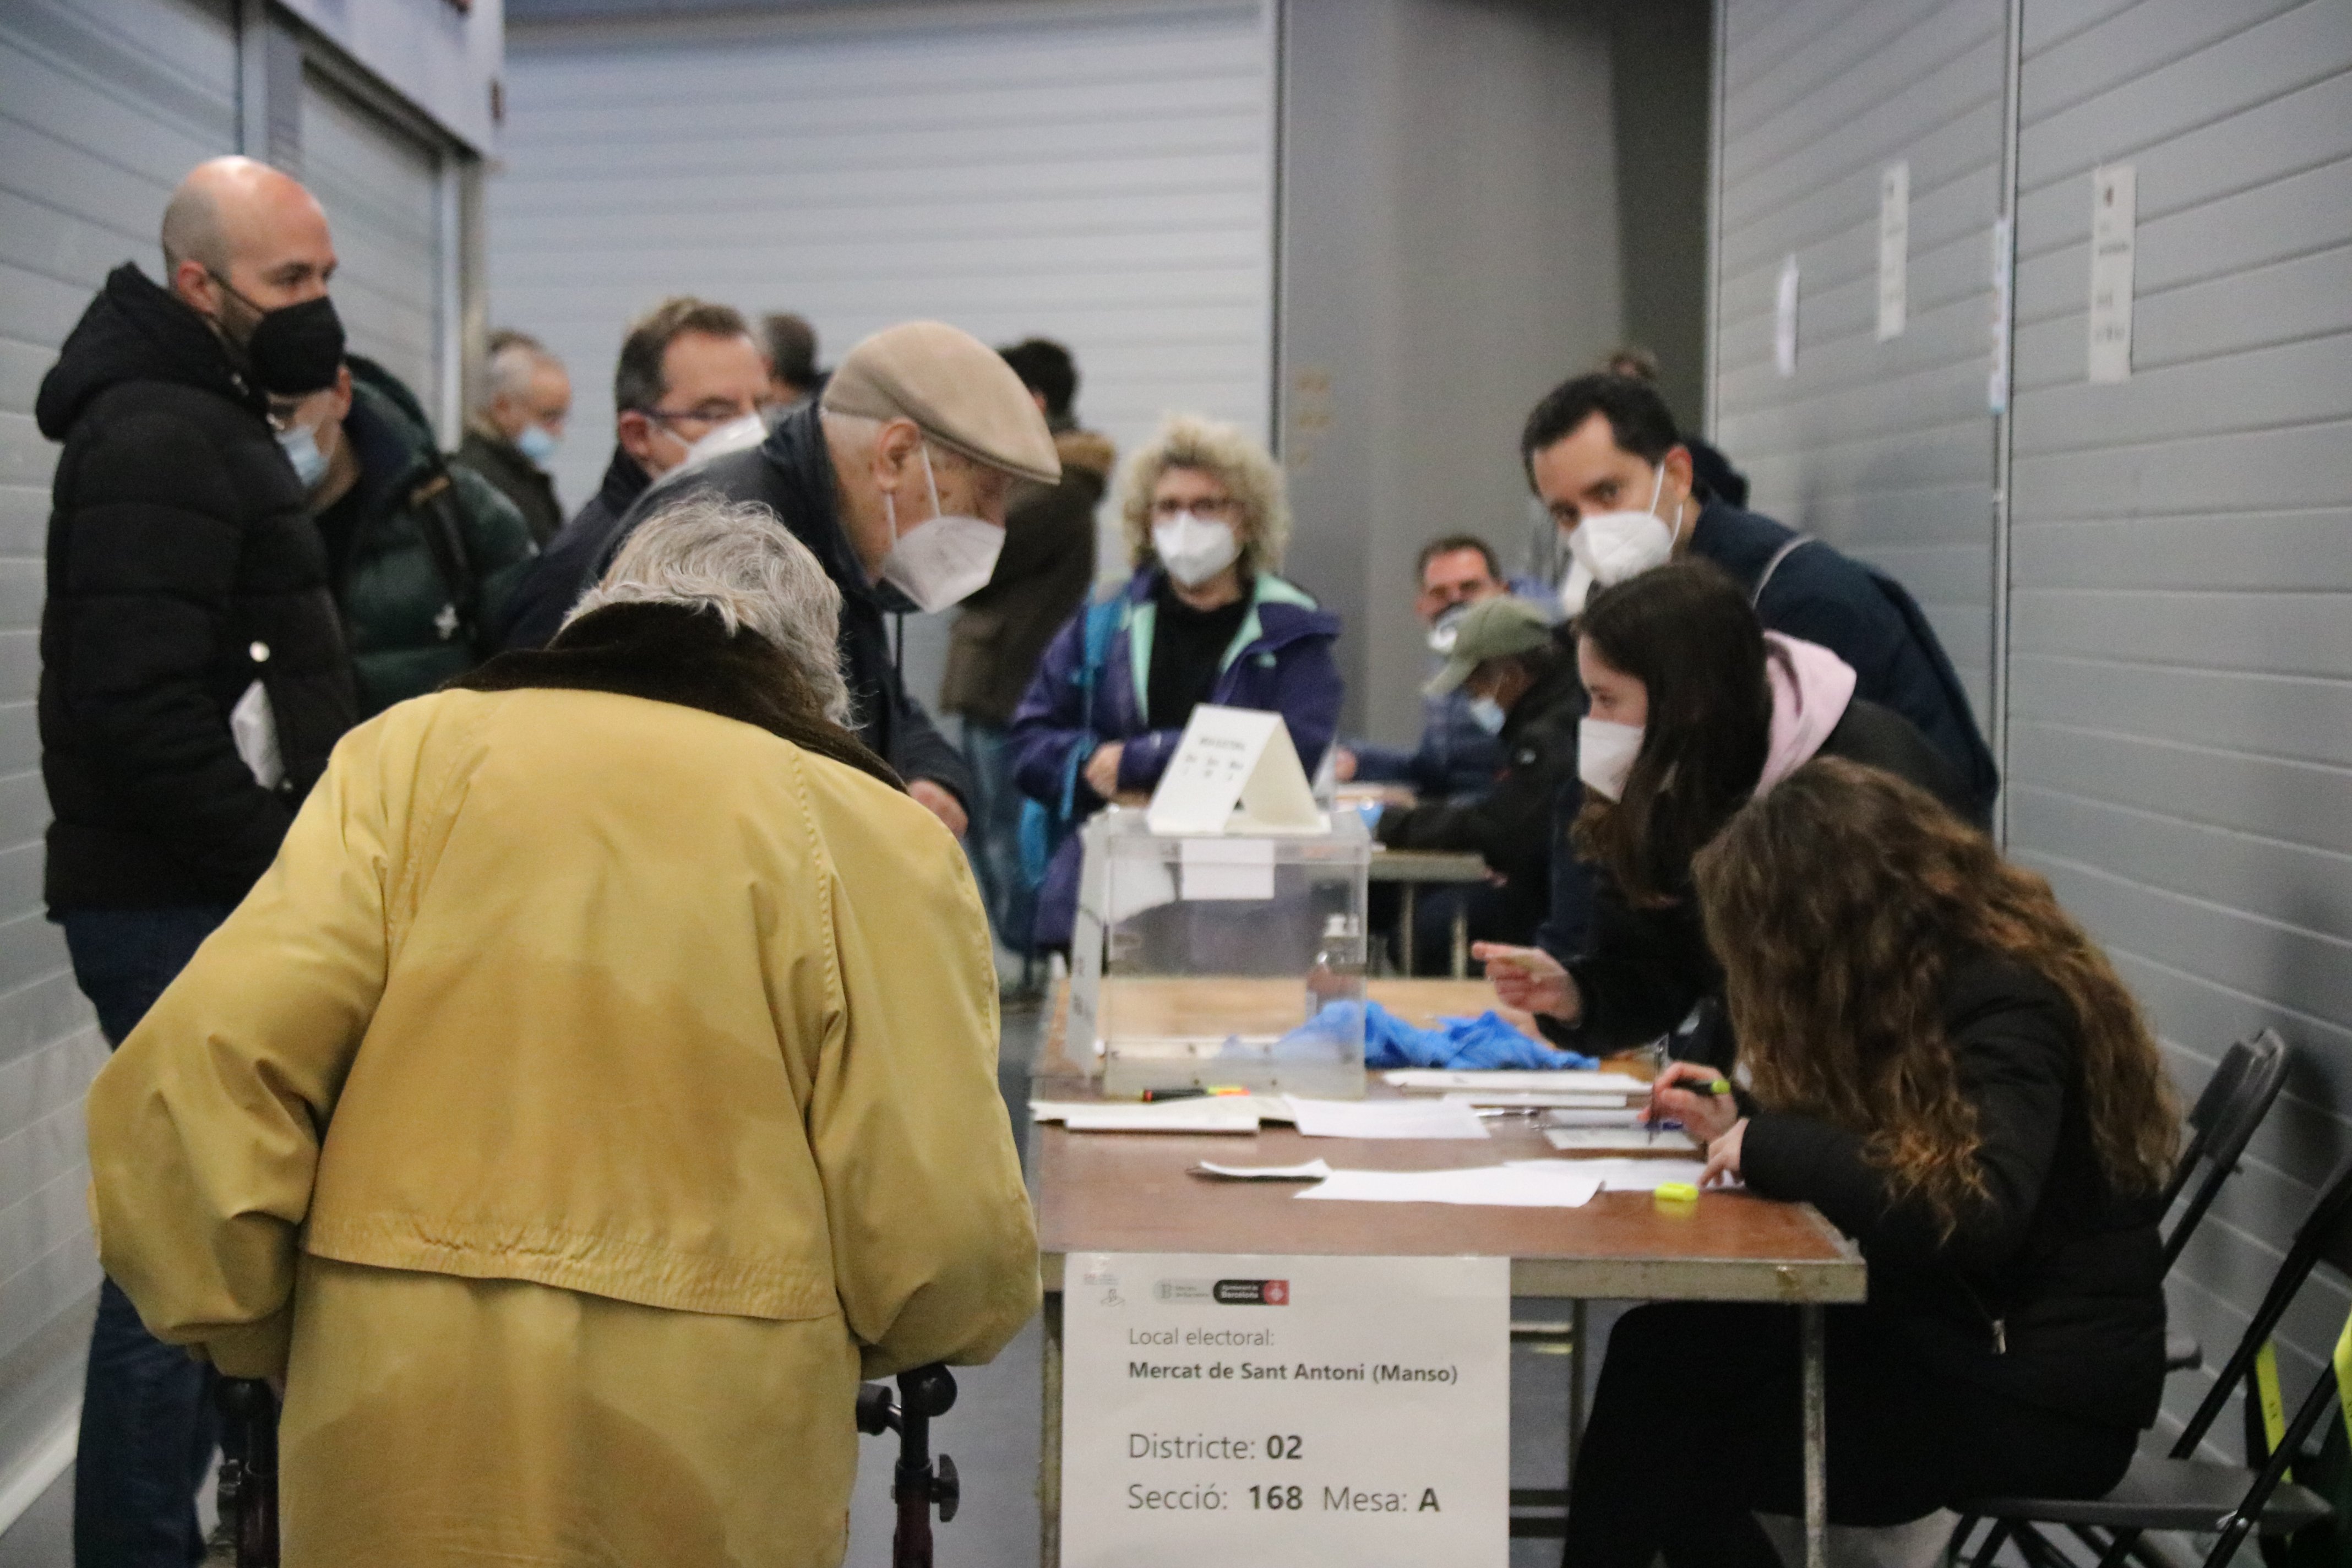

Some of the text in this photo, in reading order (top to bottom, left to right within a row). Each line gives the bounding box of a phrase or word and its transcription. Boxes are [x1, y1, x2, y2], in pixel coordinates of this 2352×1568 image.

[1129, 1328, 1275, 1347] Local electoral:
[1128, 1360, 1458, 1386] Mercat de Sant Antoni (Manso)
[1129, 1433, 1304, 1461] Districte: 02
[1128, 1483, 1441, 1513] Secció: 168 Mesa: A
